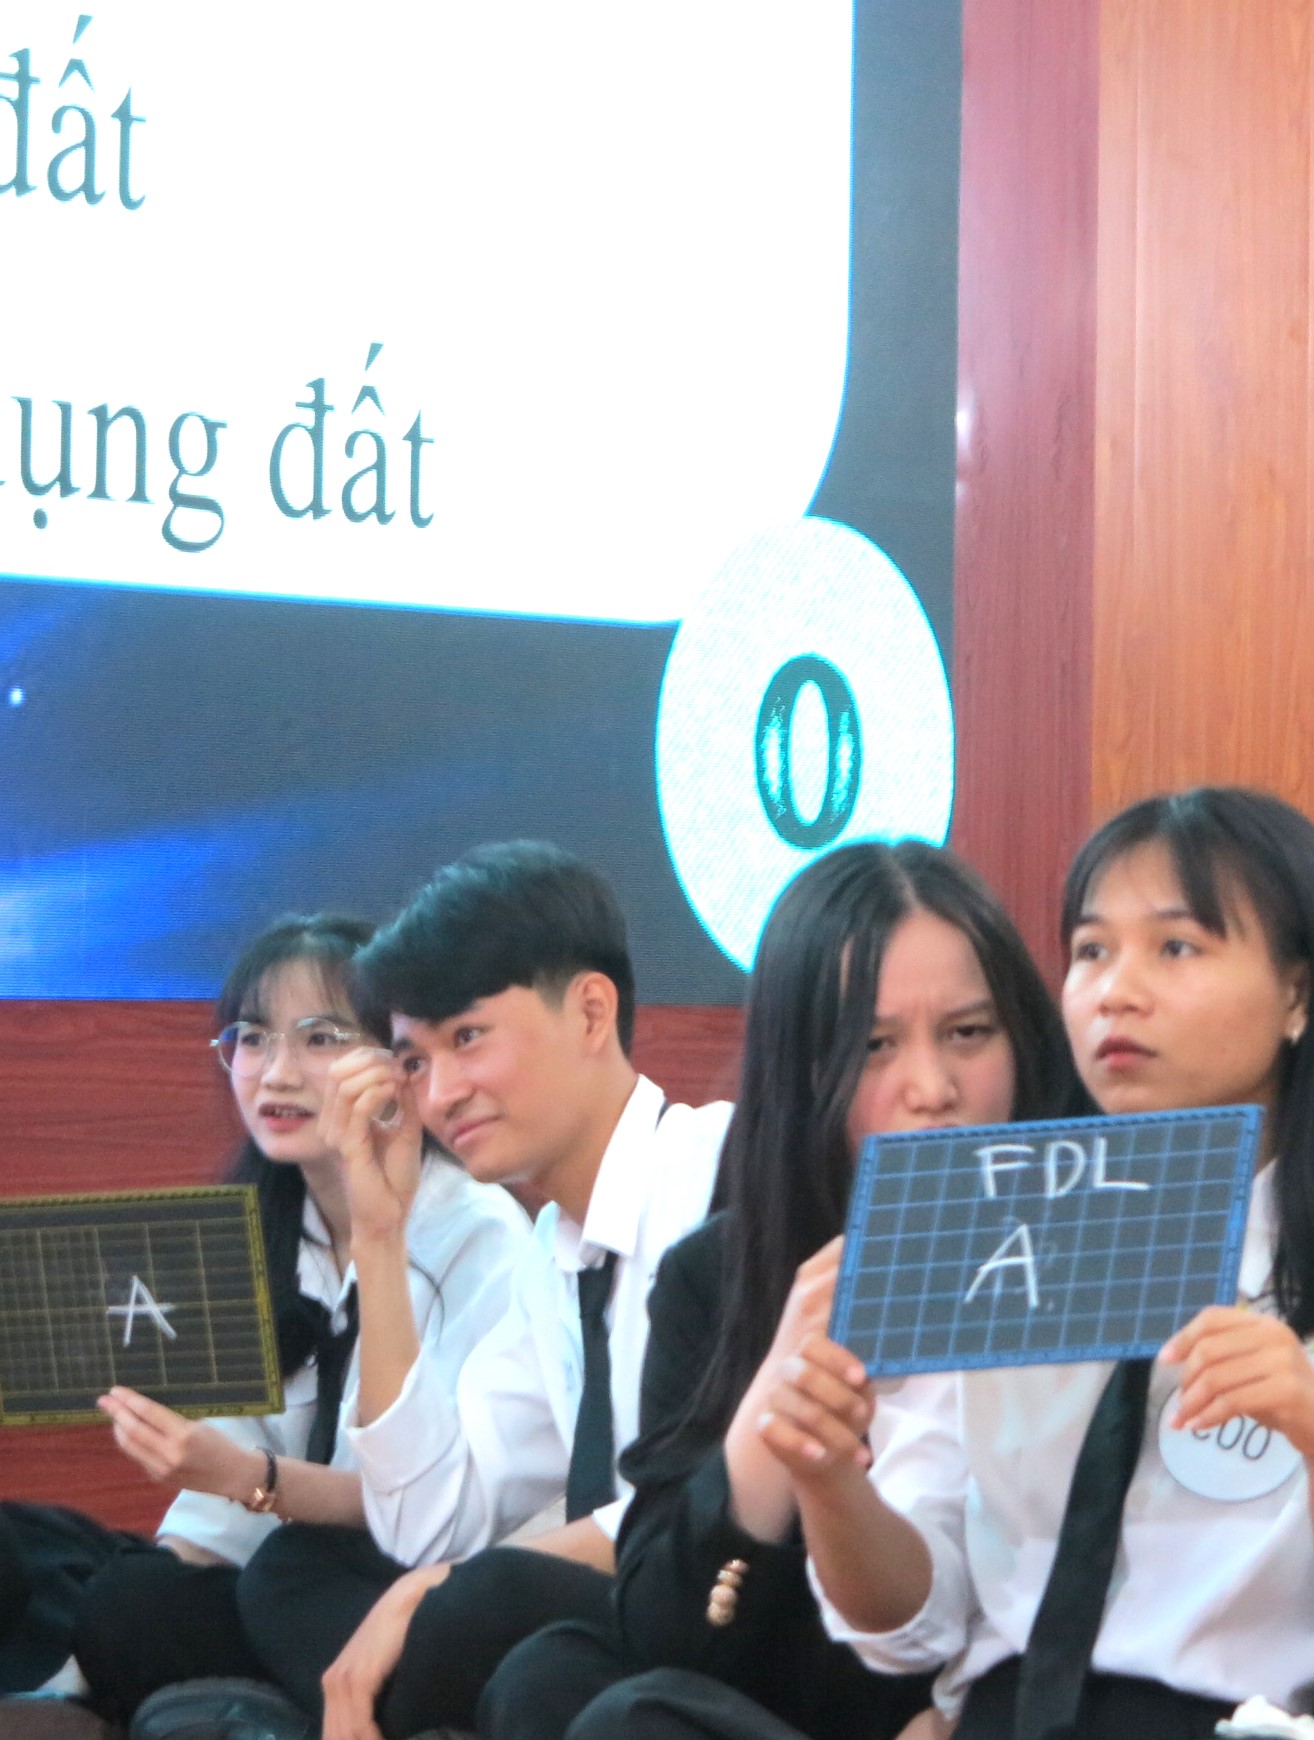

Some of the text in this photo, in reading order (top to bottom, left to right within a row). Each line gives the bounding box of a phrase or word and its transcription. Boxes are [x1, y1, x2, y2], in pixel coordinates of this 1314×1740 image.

[0, 342, 435, 553] ụng đất
[755, 652, 862, 850] 0
[973, 1137, 1150, 1198] FDL
[963, 1223, 1041, 1310] A
[106, 1274, 177, 1347] A
[1190, 1413, 1273, 1461] 00
